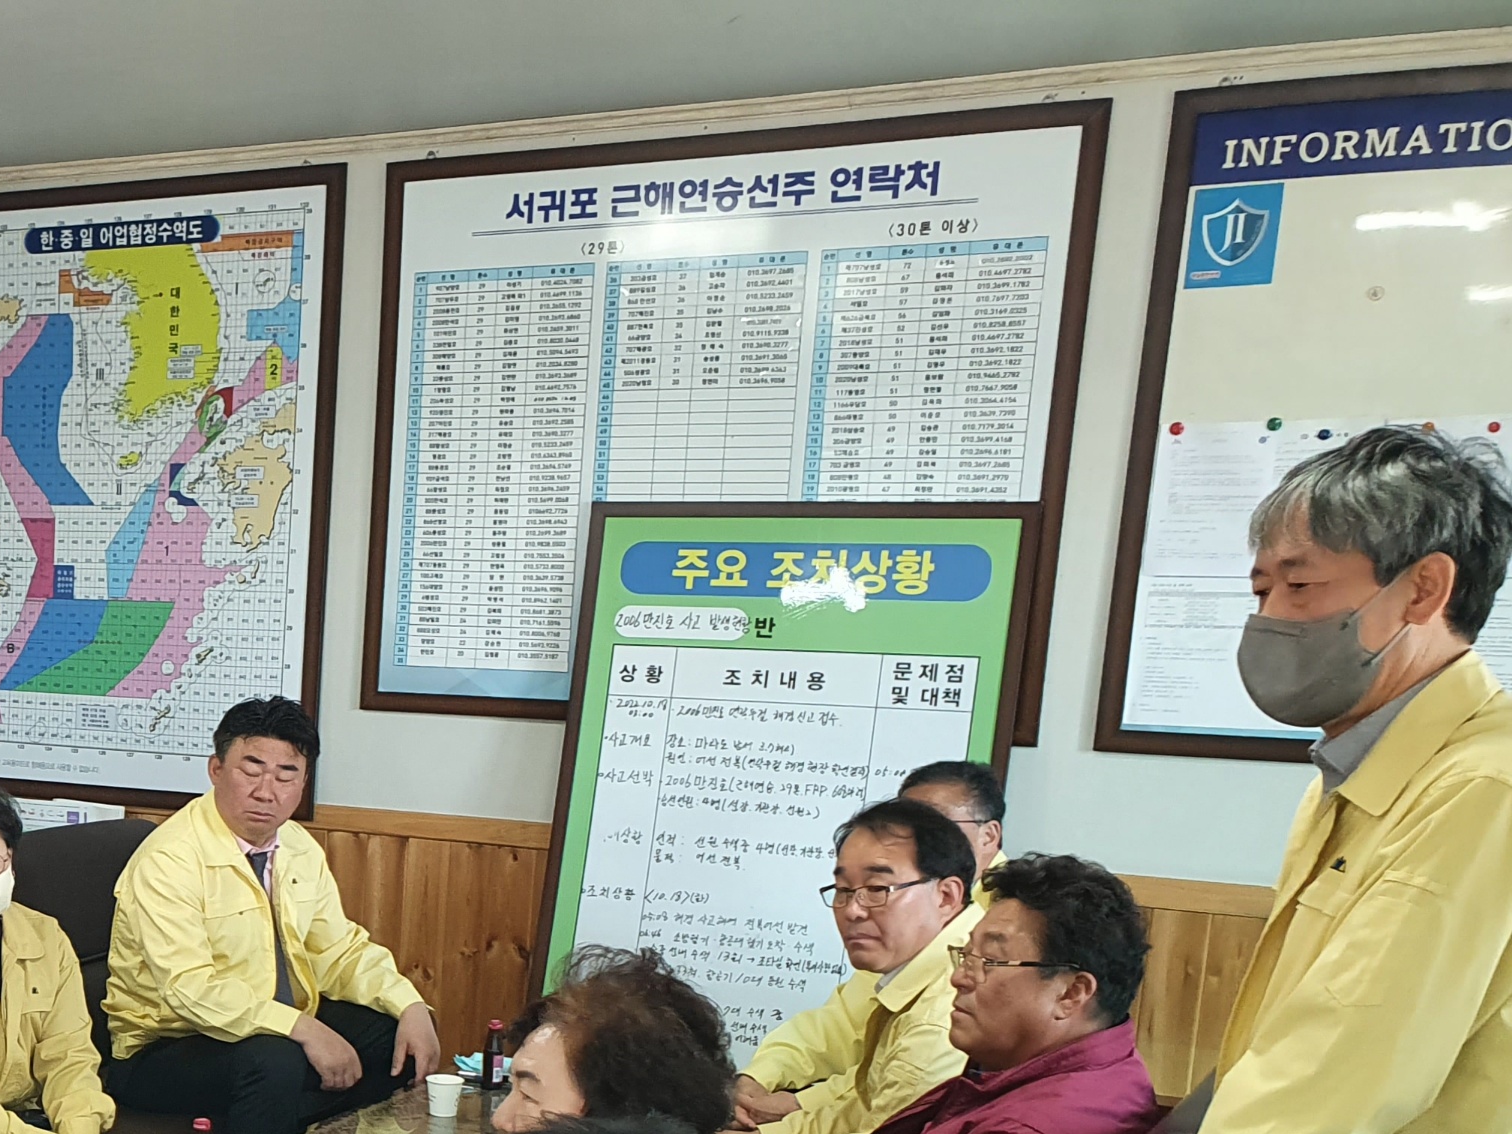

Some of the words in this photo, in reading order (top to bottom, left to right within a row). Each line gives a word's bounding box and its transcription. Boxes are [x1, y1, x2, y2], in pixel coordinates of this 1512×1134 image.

[1221, 119, 1512, 169] INFORMATIO
[506, 186, 598, 224] 서귀포
[610, 171, 815, 219] 근해연승선주
[830, 160, 940, 203] 연락처
[99, 220, 203, 246] 어업협정수역도
[168, 286, 181, 355] 대한민국
[269, 364, 278, 376] 2
[672, 549, 748, 589] 주요
[766, 549, 935, 595] 조치상황
[679, 612, 701, 629] 사고
[709, 612, 752, 634] 발생현황
[754, 617, 776, 638] 반
[6, 643, 15, 653] B
[893, 661, 965, 683] 문제점
[891, 686, 908, 705] 및
[920, 687, 962, 707] 대책
[797, 711, 815, 723] 신고
[695, 756, 716, 767] 어선
[603, 768, 653, 787] 사고선박
[695, 836, 719, 849] 선원
[695, 852, 717, 863] 어선
[587, 885, 636, 901] 조치상황
[787, 922, 808, 936] 발견
[691, 949, 710, 962] 수색
[793, 941, 815, 956] 수색
[706, 969, 732, 983] 항공기
[787, 977, 806, 992] 수색
[746, 1007, 765, 1020] 수색
[771, 1009, 783, 1020] 중
[750, 1023, 768, 1034] 수색
